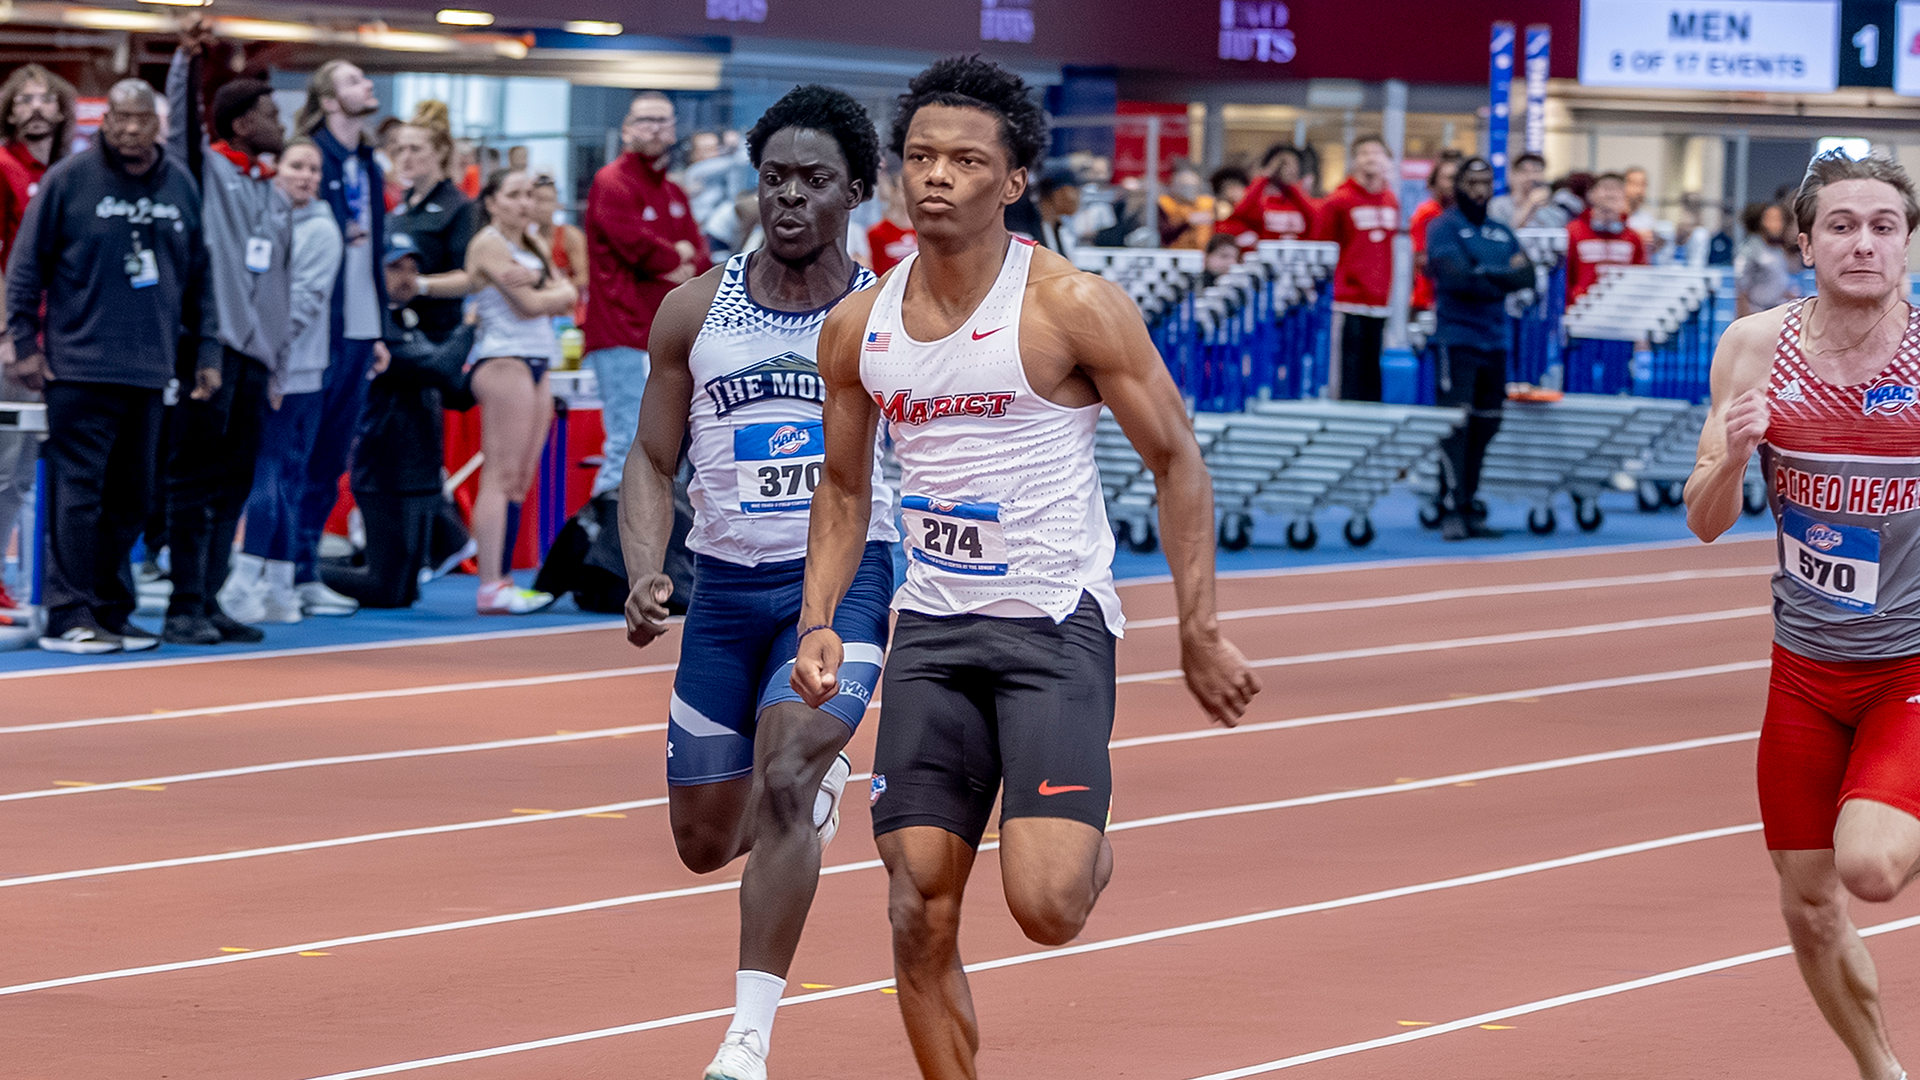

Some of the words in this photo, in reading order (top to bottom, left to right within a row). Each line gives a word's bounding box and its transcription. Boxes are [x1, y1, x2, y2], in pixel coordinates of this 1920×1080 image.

[1668, 11, 1751, 42] MEN
[1852, 23, 1880, 68] 1
[1631, 52, 1665, 74] OF
[1705, 53, 1807, 78] EVENTS
[705, 373, 765, 416] THE
[1865, 384, 1915, 411] MAAC
[757, 462, 823, 498] 370
[1846, 476, 1920, 515] HEAR
[922, 517, 983, 559] 274
[1798, 546, 1856, 593] 570
